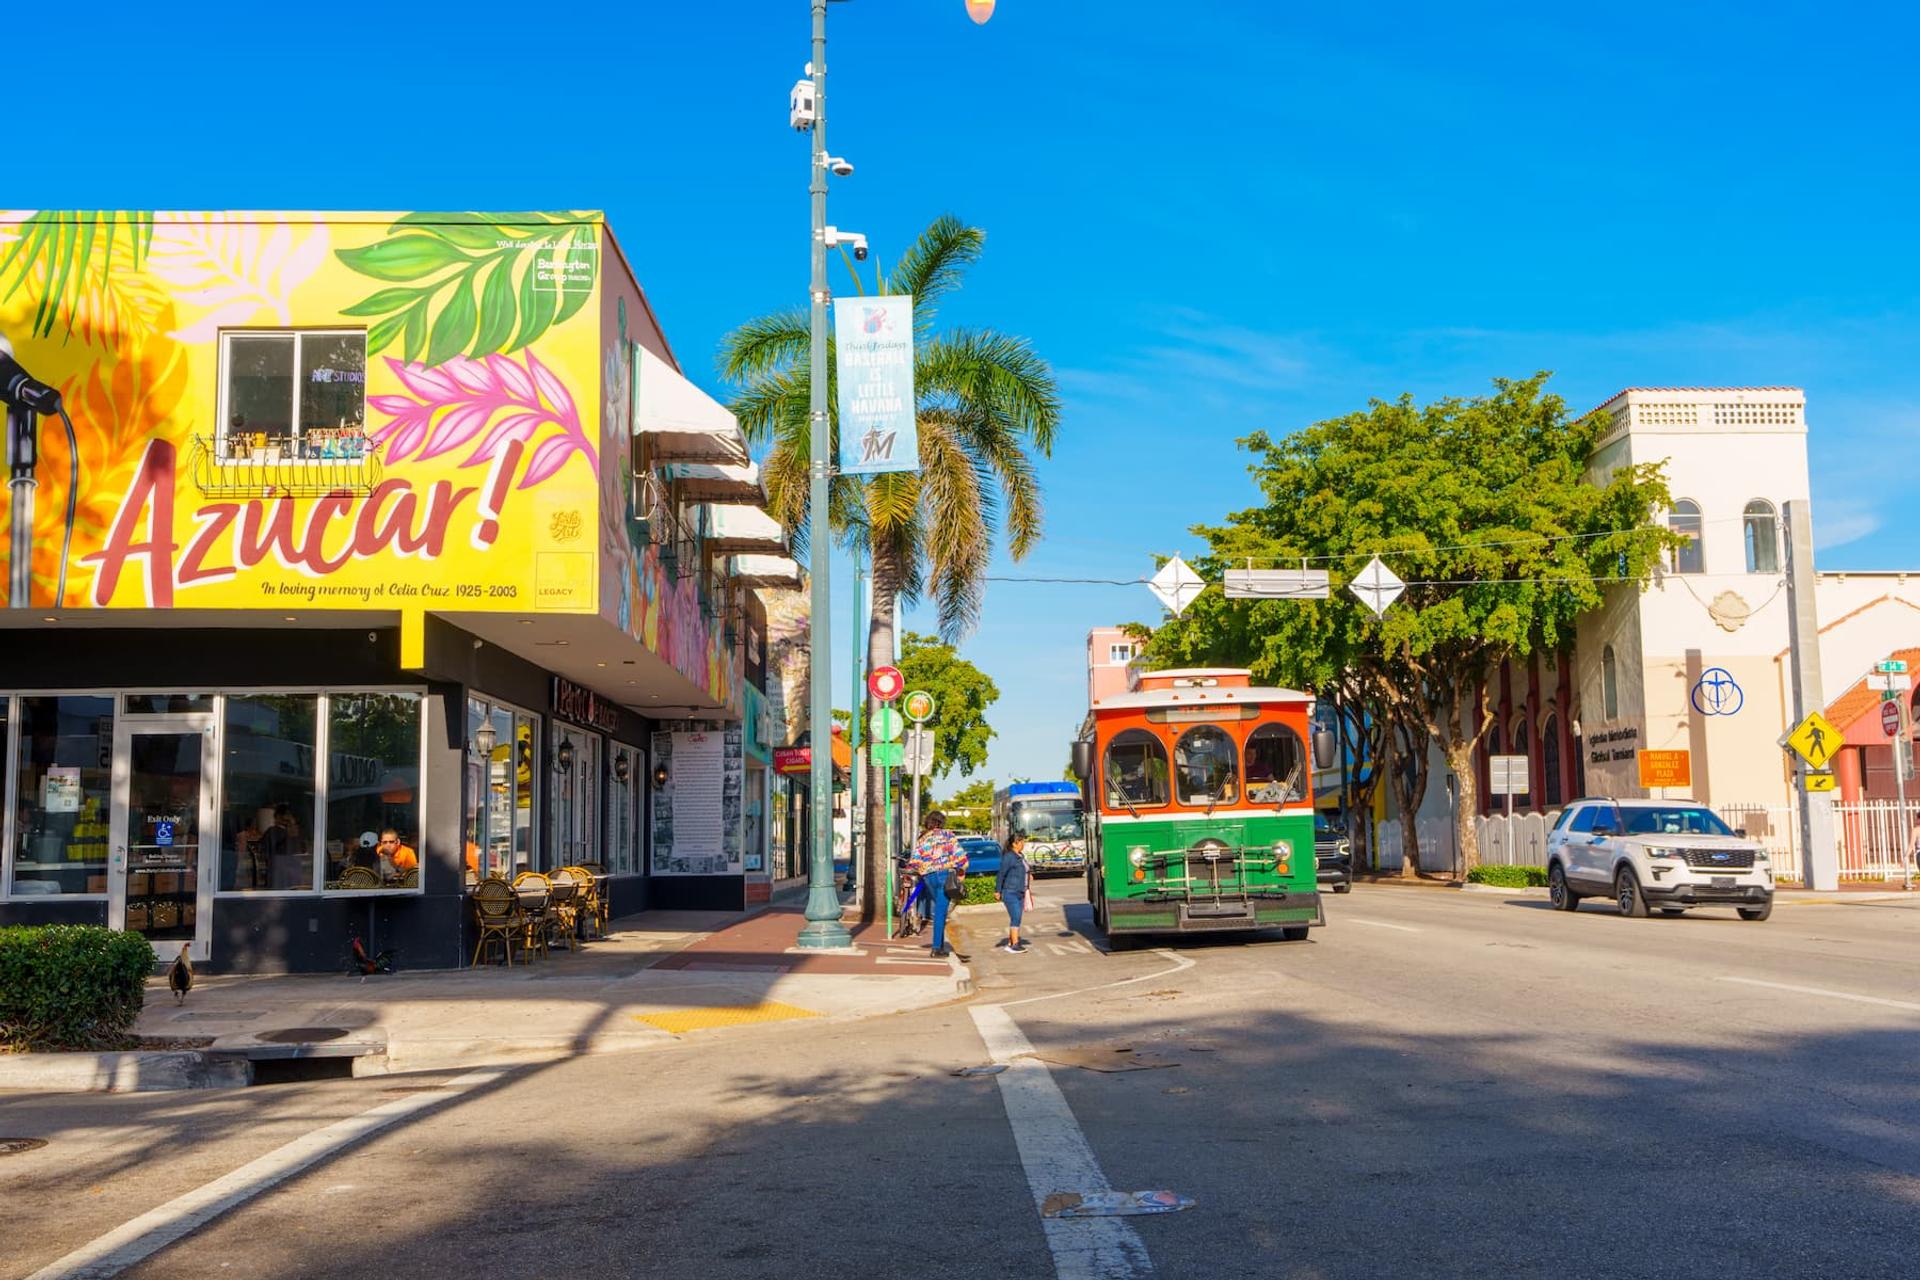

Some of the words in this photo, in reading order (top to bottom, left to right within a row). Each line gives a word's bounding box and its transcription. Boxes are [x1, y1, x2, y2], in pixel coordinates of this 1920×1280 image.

[858, 383, 896, 398] LITTLE
[851, 398, 903, 415] HAVANA
[261, 581, 276, 595] In
[279, 582, 316, 601] loving
[318, 585, 371, 601] memory
[374, 583, 384, 596] of
[389, 582, 418, 597] Celia
[421, 583, 450, 598] Cruz
[456, 584, 518, 598] 1925-2003
[538, 588, 574, 596] LEGACY
[147, 815, 162, 824] Exit
[163, 815, 181, 825] Only
